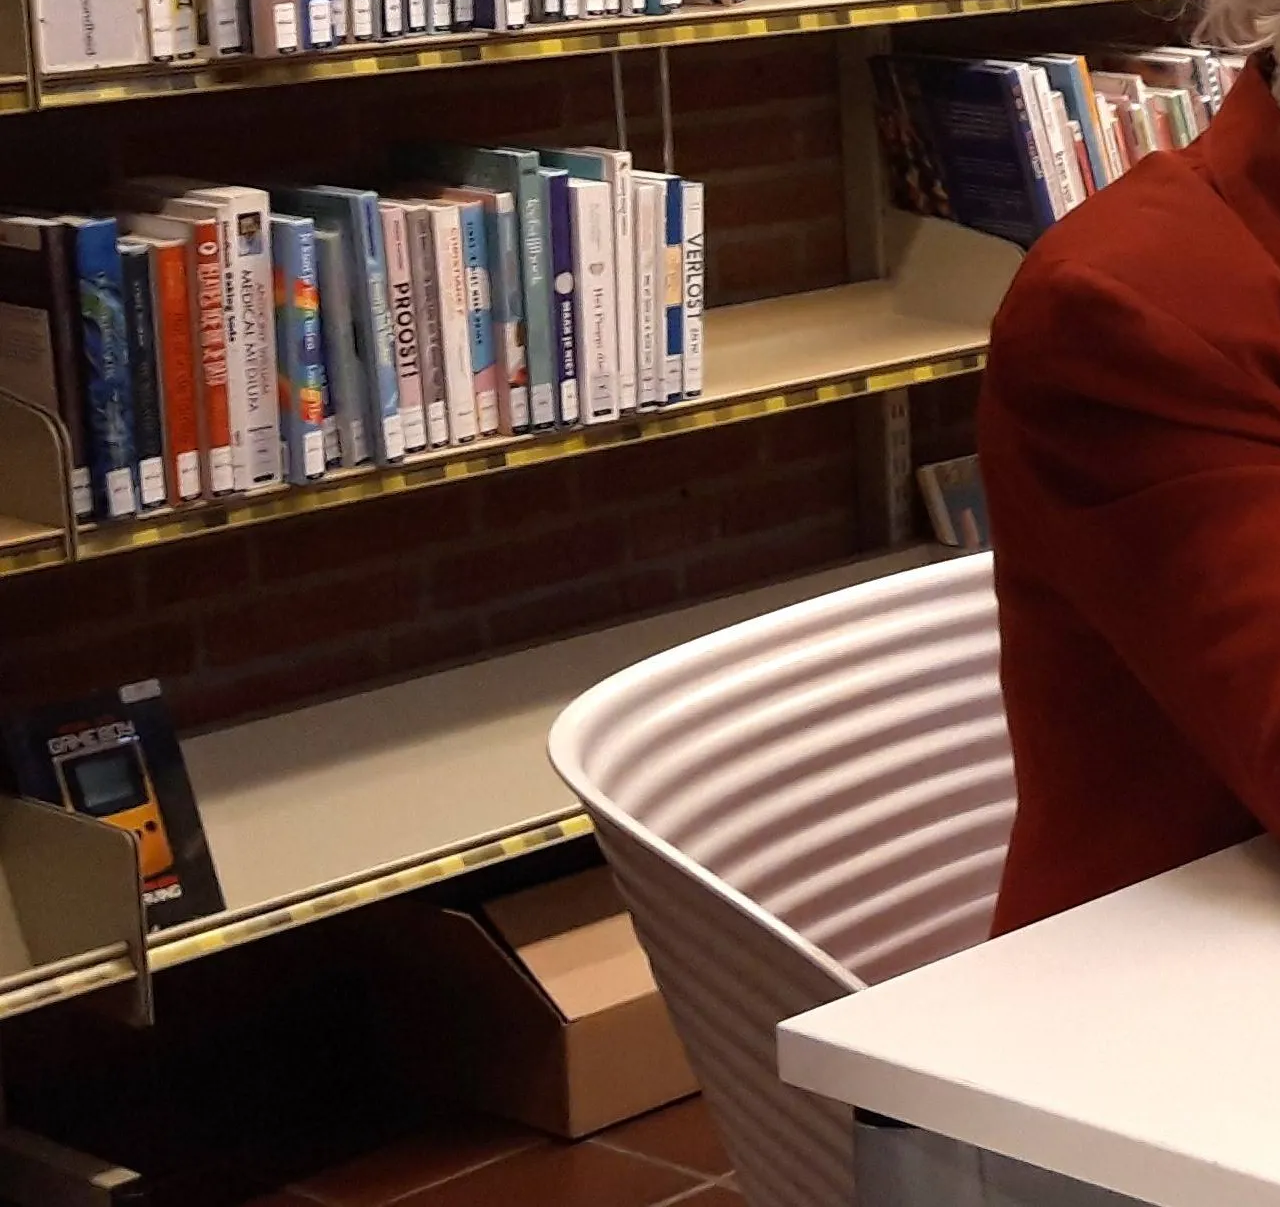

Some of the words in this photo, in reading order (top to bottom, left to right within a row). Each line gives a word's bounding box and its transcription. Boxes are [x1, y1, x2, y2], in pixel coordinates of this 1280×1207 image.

[241, 269, 256, 336] MEDICAL
[686, 233, 702, 319] VERLOST
[393, 282, 419, 378] PROOST!
